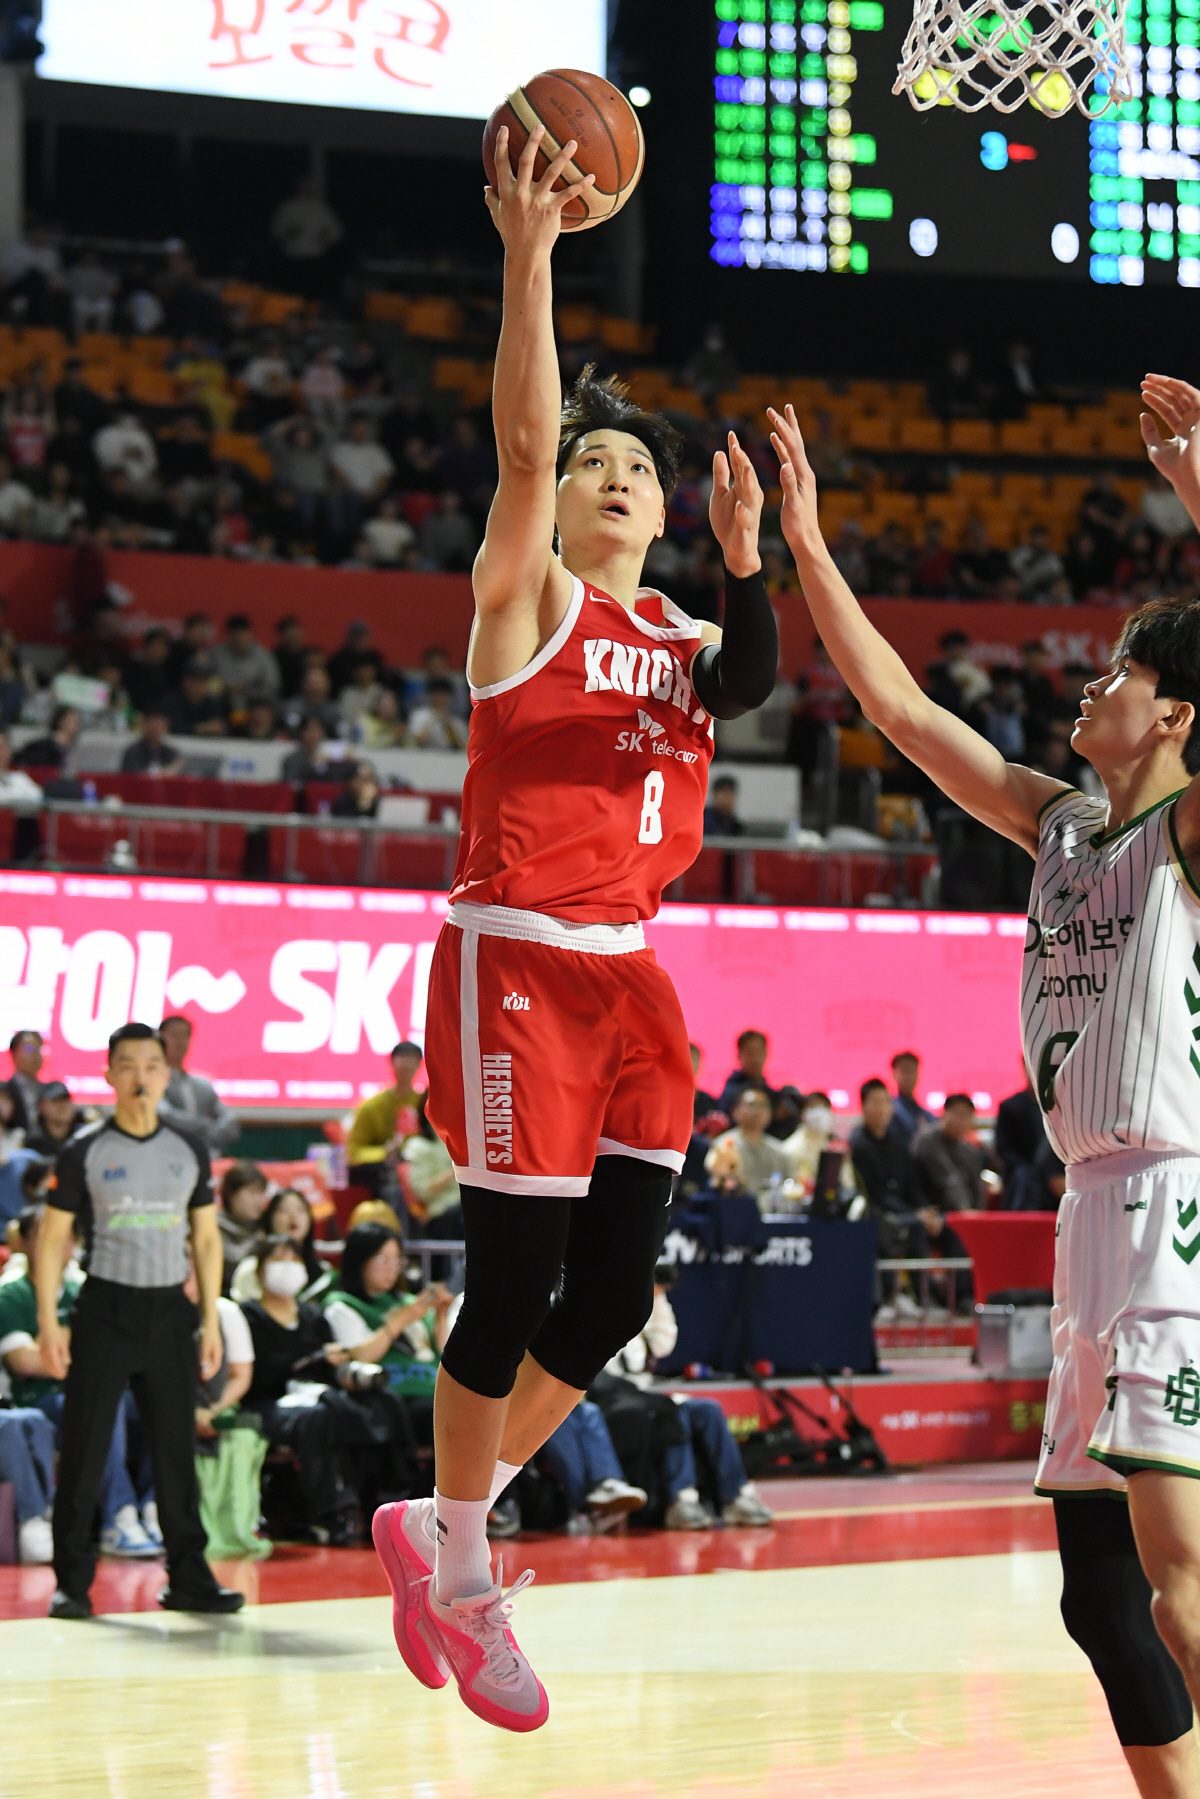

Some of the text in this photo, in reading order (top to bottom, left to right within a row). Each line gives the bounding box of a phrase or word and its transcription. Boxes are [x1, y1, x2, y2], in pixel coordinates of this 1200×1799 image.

[614, 731, 645, 752] SK
[638, 770, 665, 845] 8
[502, 991, 531, 1011] KBL
[482, 1054, 513, 1165] HERSHEY'S
